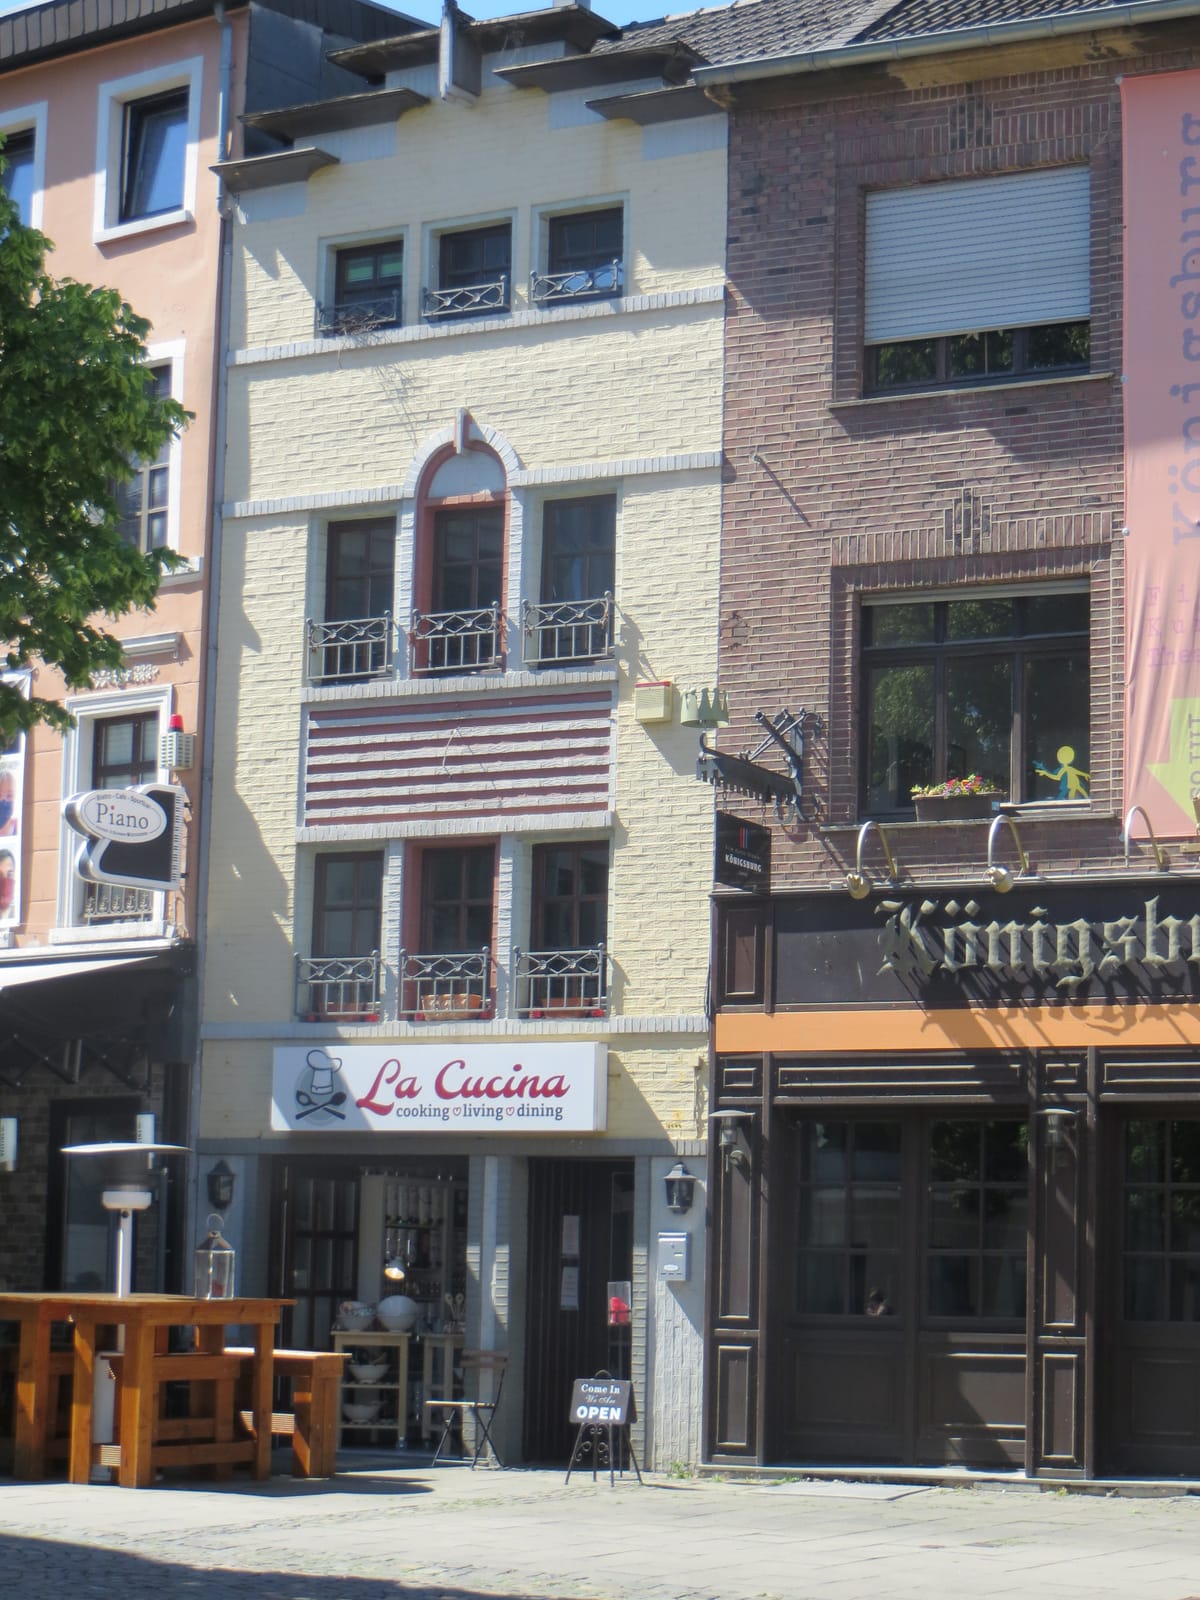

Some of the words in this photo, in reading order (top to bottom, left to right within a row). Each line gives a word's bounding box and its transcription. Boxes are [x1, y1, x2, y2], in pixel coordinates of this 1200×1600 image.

[96, 802, 149, 830] Piano
[725, 853, 762, 873] KÖNIGSBURG
[355, 1058, 422, 1116] La
[434, 1059, 571, 1100] Cucina
[396, 1103, 450, 1120] cooking
[463, 1103, 503, 1120] living
[517, 1103, 563, 1120] dining
[581, 1383, 608, 1393] Come
[610, 1384, 620, 1394] In
[576, 1405, 622, 1420] OPEN
